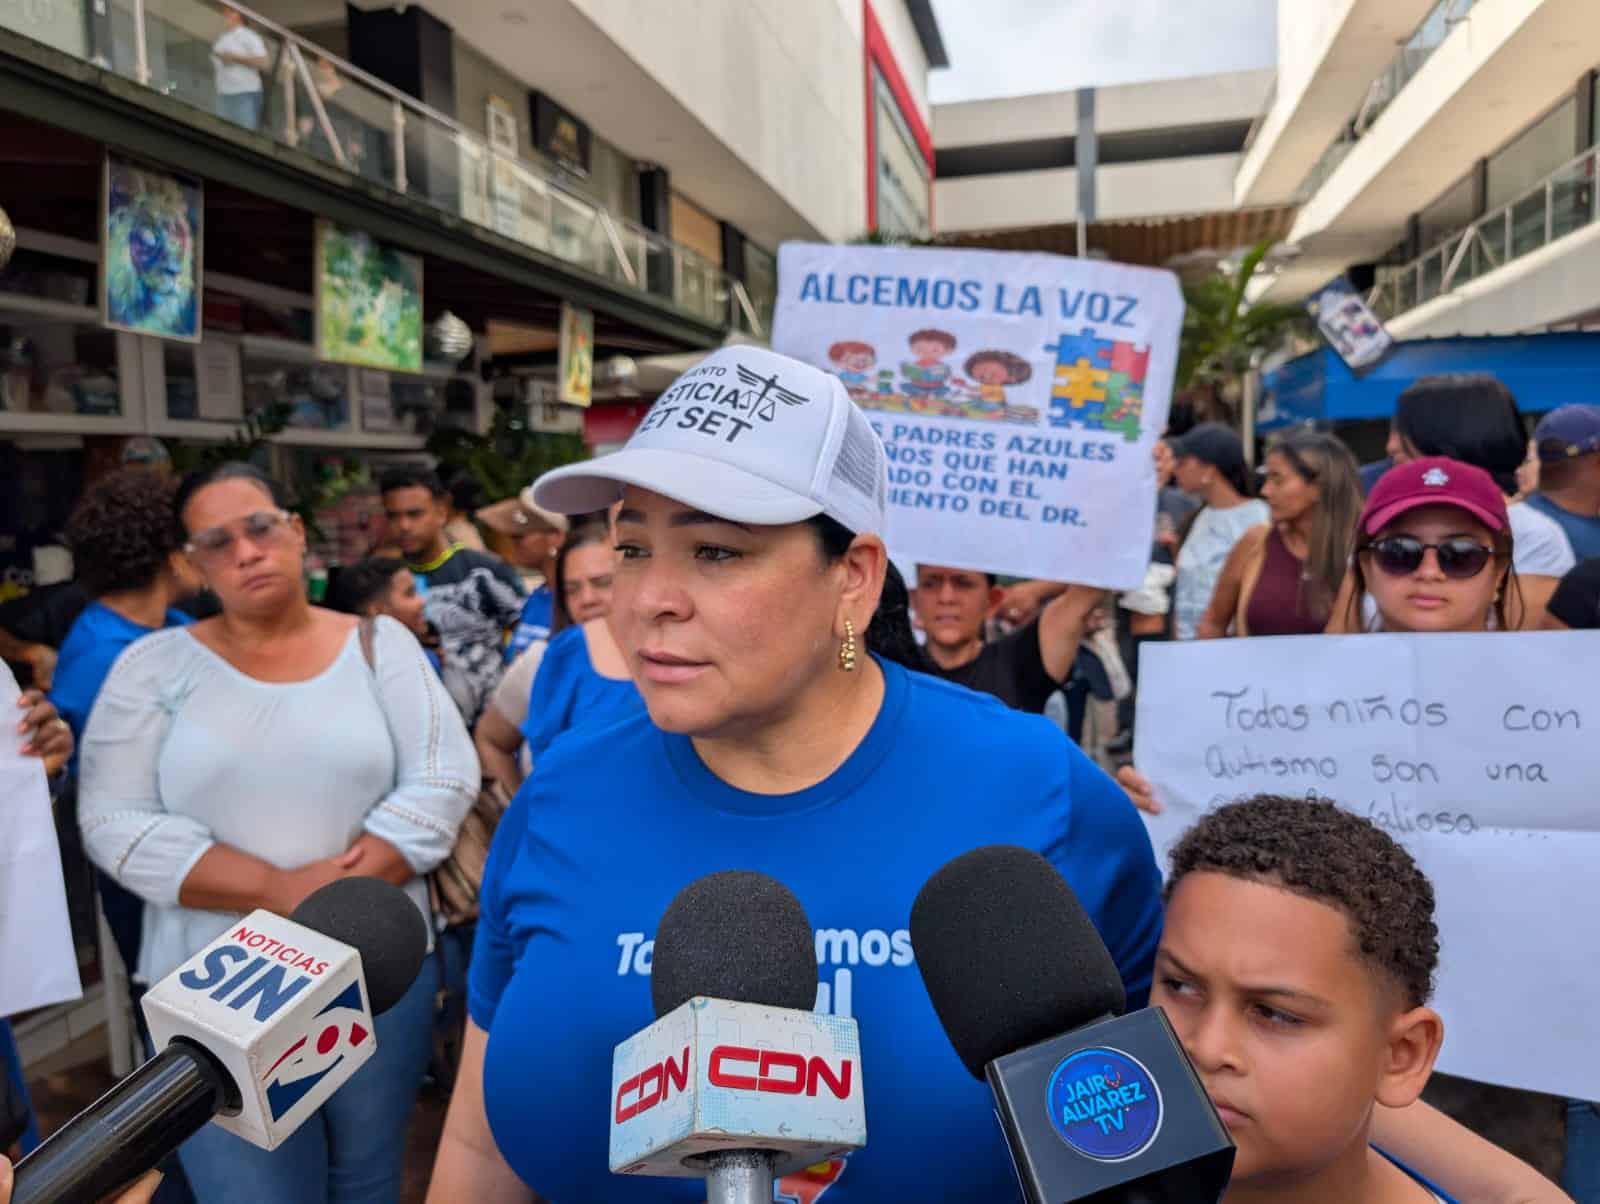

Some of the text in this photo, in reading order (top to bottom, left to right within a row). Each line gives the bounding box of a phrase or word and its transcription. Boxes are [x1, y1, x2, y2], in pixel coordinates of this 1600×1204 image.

[800, 273, 1139, 327] ALCEMOS LA VOZ
[661, 382, 739, 410] STICIA
[641, 406, 752, 443] ET SET
[893, 424, 995, 450] PADRES
[1007, 436, 1116, 462] AZULES
[885, 441, 1068, 481] ÑOS QUE HAN
[942, 472, 998, 494] CON
[1008, 480, 1042, 501] EL
[888, 488, 1088, 527] IENTO DEL DR.
[1485, 762, 1549, 783] una
[230, 926, 331, 977] NOTICIAS
[617, 928, 915, 976] To mos
[179, 944, 312, 1023] SIN
[615, 1046, 690, 1124] CDN
[708, 1045, 852, 1100] CDN
[1063, 1081, 1147, 1125] ALVAREZ
[1094, 1110, 1124, 1135] TV
